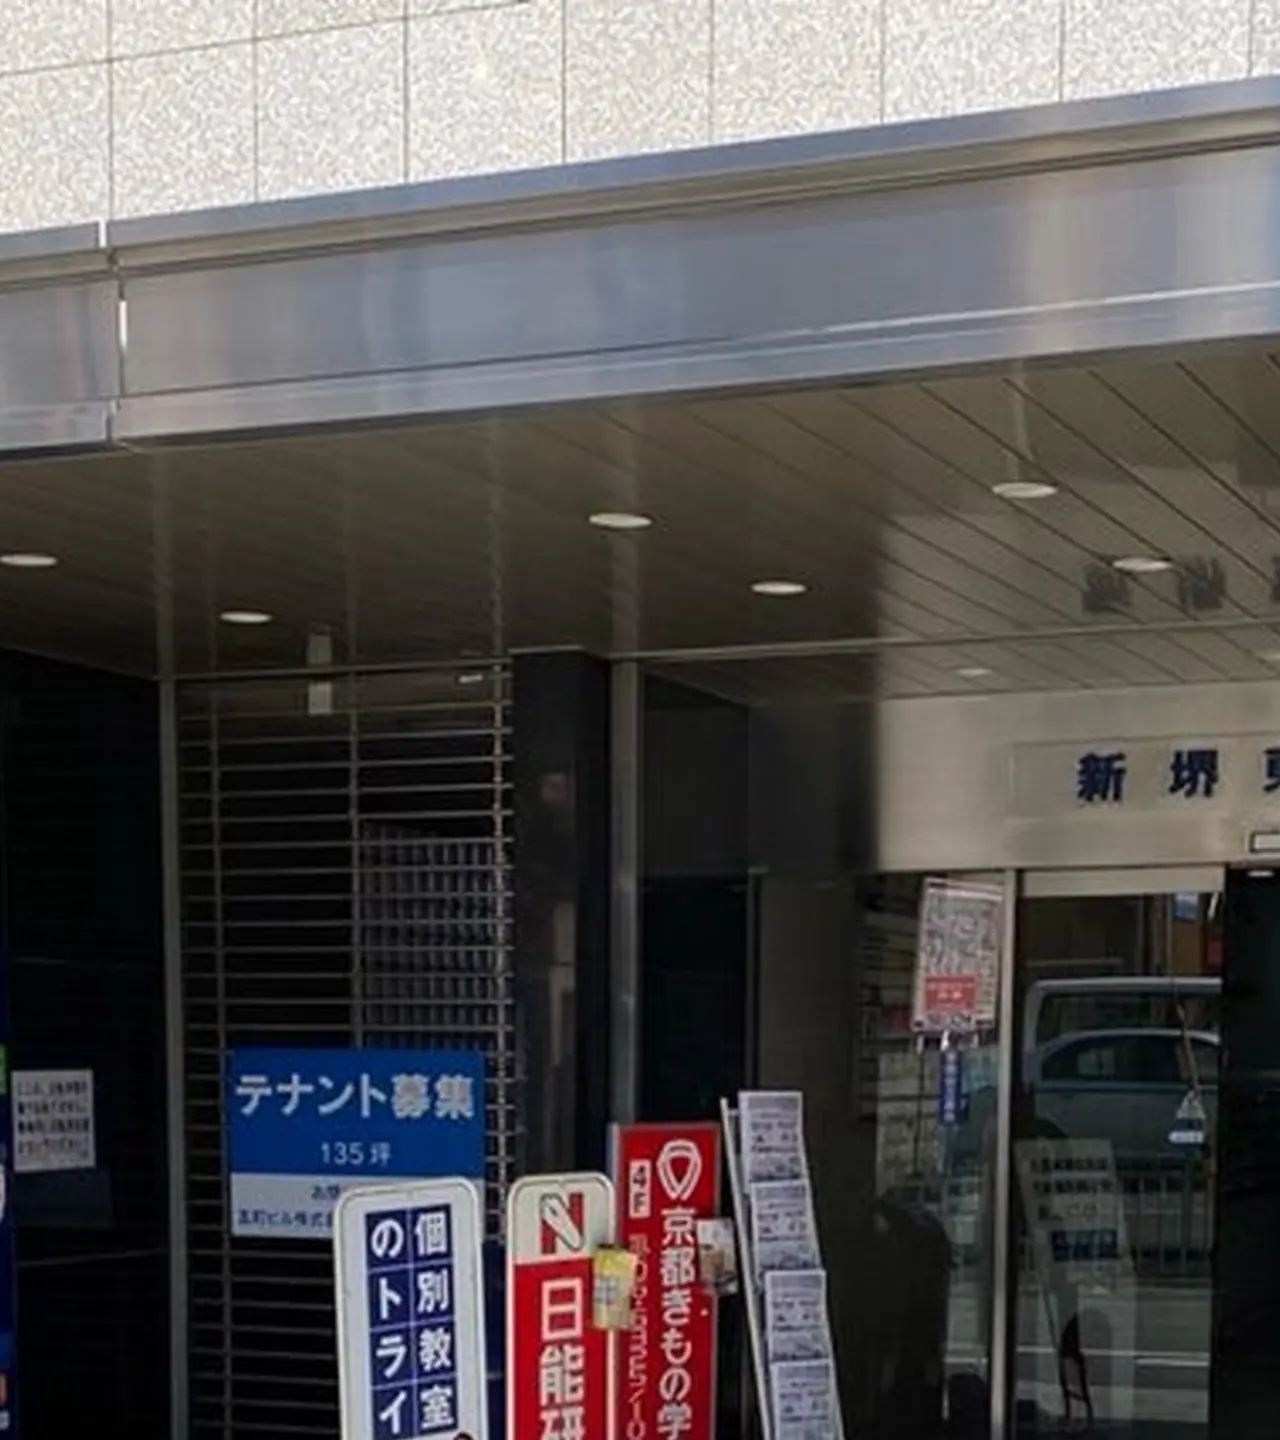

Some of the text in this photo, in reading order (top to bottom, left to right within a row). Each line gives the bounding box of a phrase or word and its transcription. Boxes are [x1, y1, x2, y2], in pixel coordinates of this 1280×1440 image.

[235, 1072, 475, 1120] テナント募集
[371, 1219, 408, 1436] のトライ
[415, 1212, 456, 1430] 個別教室
